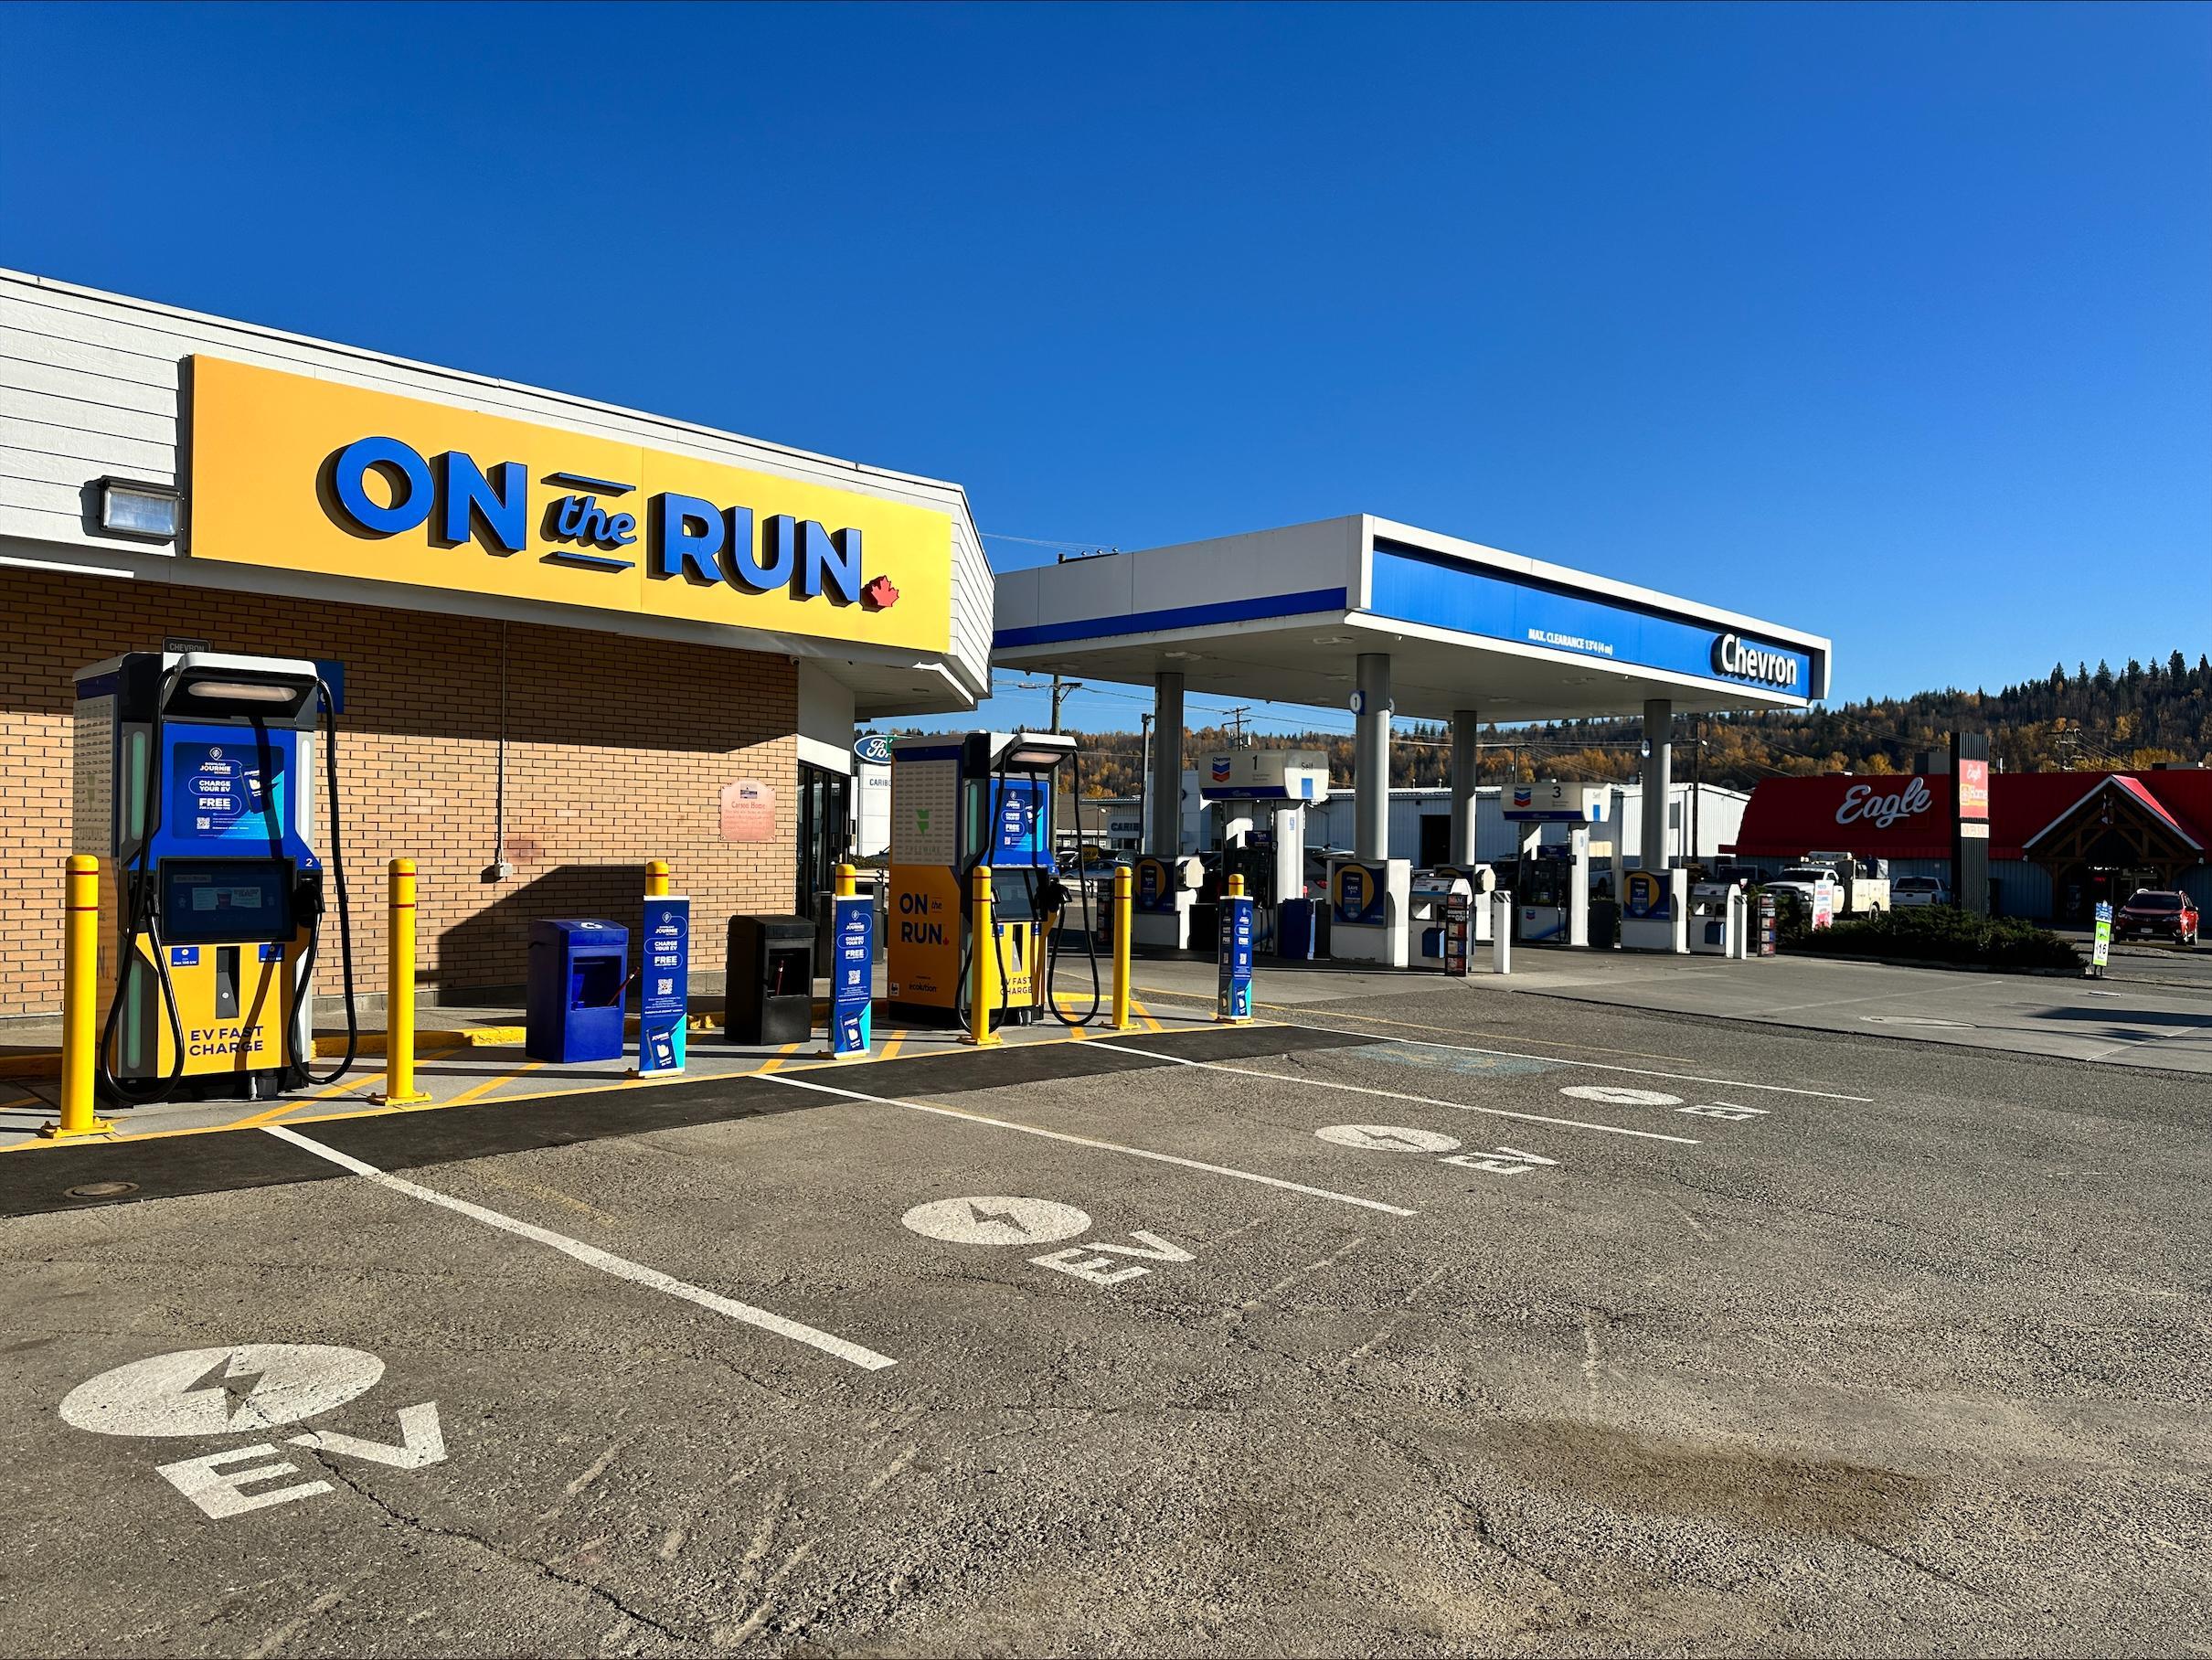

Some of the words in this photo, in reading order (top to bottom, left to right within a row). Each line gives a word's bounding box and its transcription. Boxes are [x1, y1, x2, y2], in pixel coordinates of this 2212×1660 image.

[331, 436, 528, 553] ON
[554, 495, 638, 547] the
[169, 643, 205, 652] CHEVRON
[1528, 628, 1547, 642] MAX.
[1547, 632, 1585, 649] CLEARANCE
[1720, 633, 1797, 686] Chevron
[1354, 697, 1358, 708] 1
[1252, 754, 1258, 771] 1
[1552, 786, 1561, 798] 3
[199, 798, 230, 807] FREE
[1835, 776, 1933, 828] Eagle
[305, 858, 314, 867] 2
[899, 893, 928, 915] ON
[931, 900, 942, 910] the
[900, 921, 942, 945] RUN
[654, 955, 677, 964] FREE
[1012, 976, 1032, 984] FAST
[190, 1029, 215, 1041] EV
[218, 1026, 264, 1039] FAST
[189, 1040, 264, 1056] CHARGE
[1674, 1101, 1771, 1121] EV
[1437, 1146, 1561, 1175] EV
[1026, 1229, 1197, 1286] EV
[154, 1400, 450, 1521] EV
